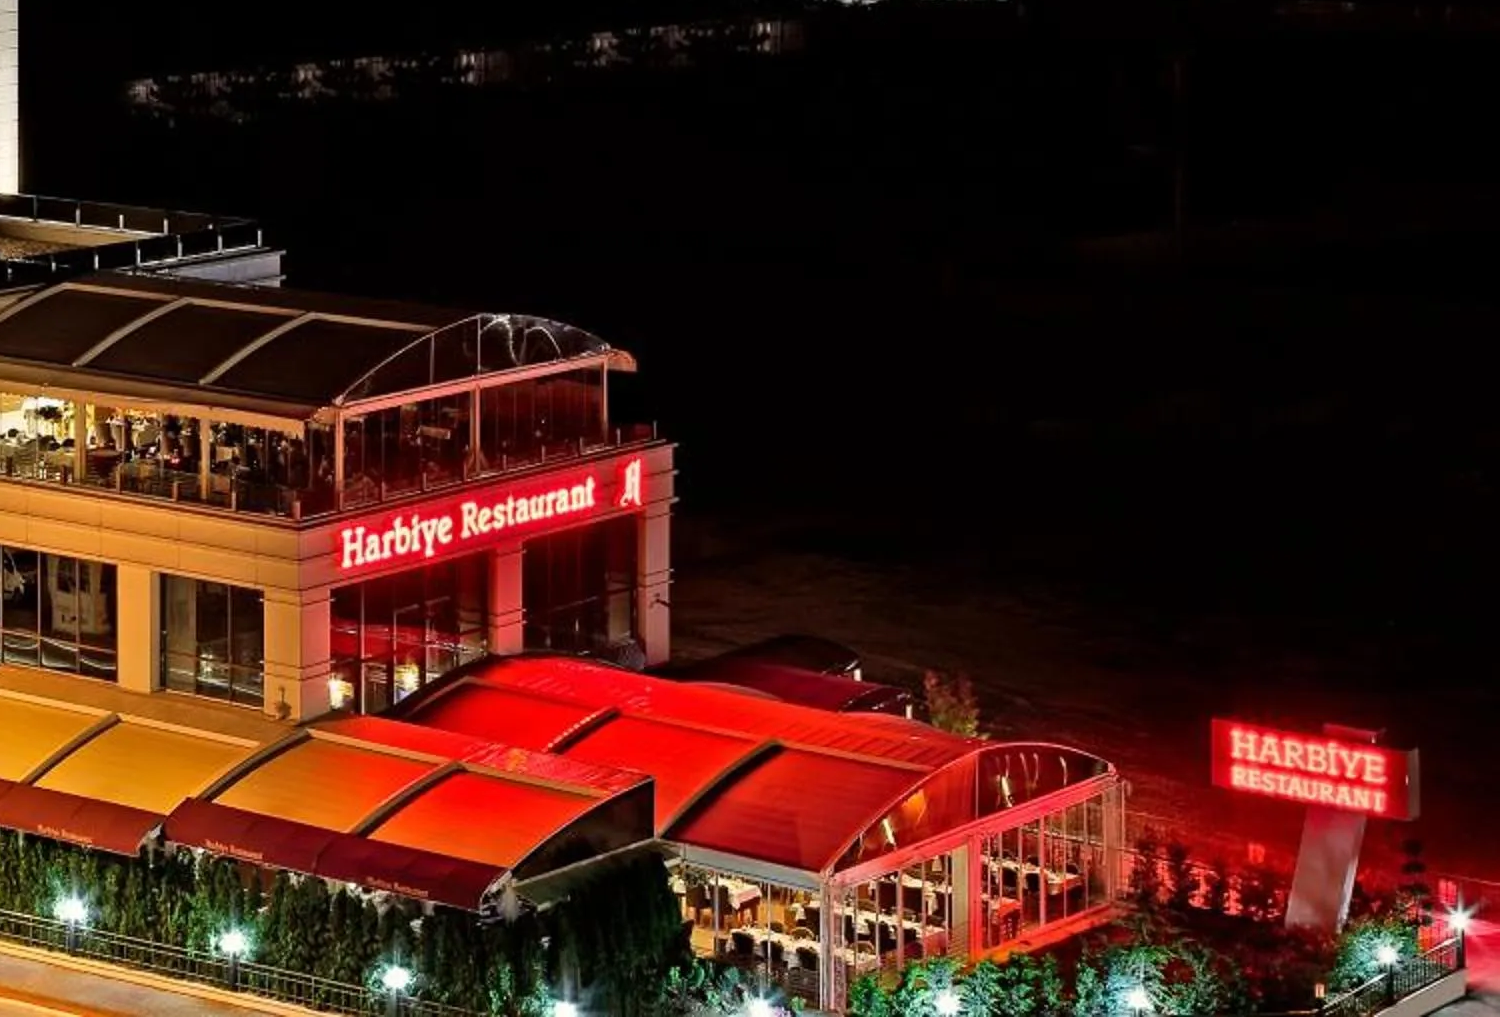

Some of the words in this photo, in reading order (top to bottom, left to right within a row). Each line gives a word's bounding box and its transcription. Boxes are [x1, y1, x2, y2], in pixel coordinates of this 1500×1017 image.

[341, 516, 453, 568] Harbiye
[461, 476, 596, 539] Restaurant
[1230, 729, 1388, 784] HARBİYE
[1230, 766, 1388, 813] RESTAURANT
